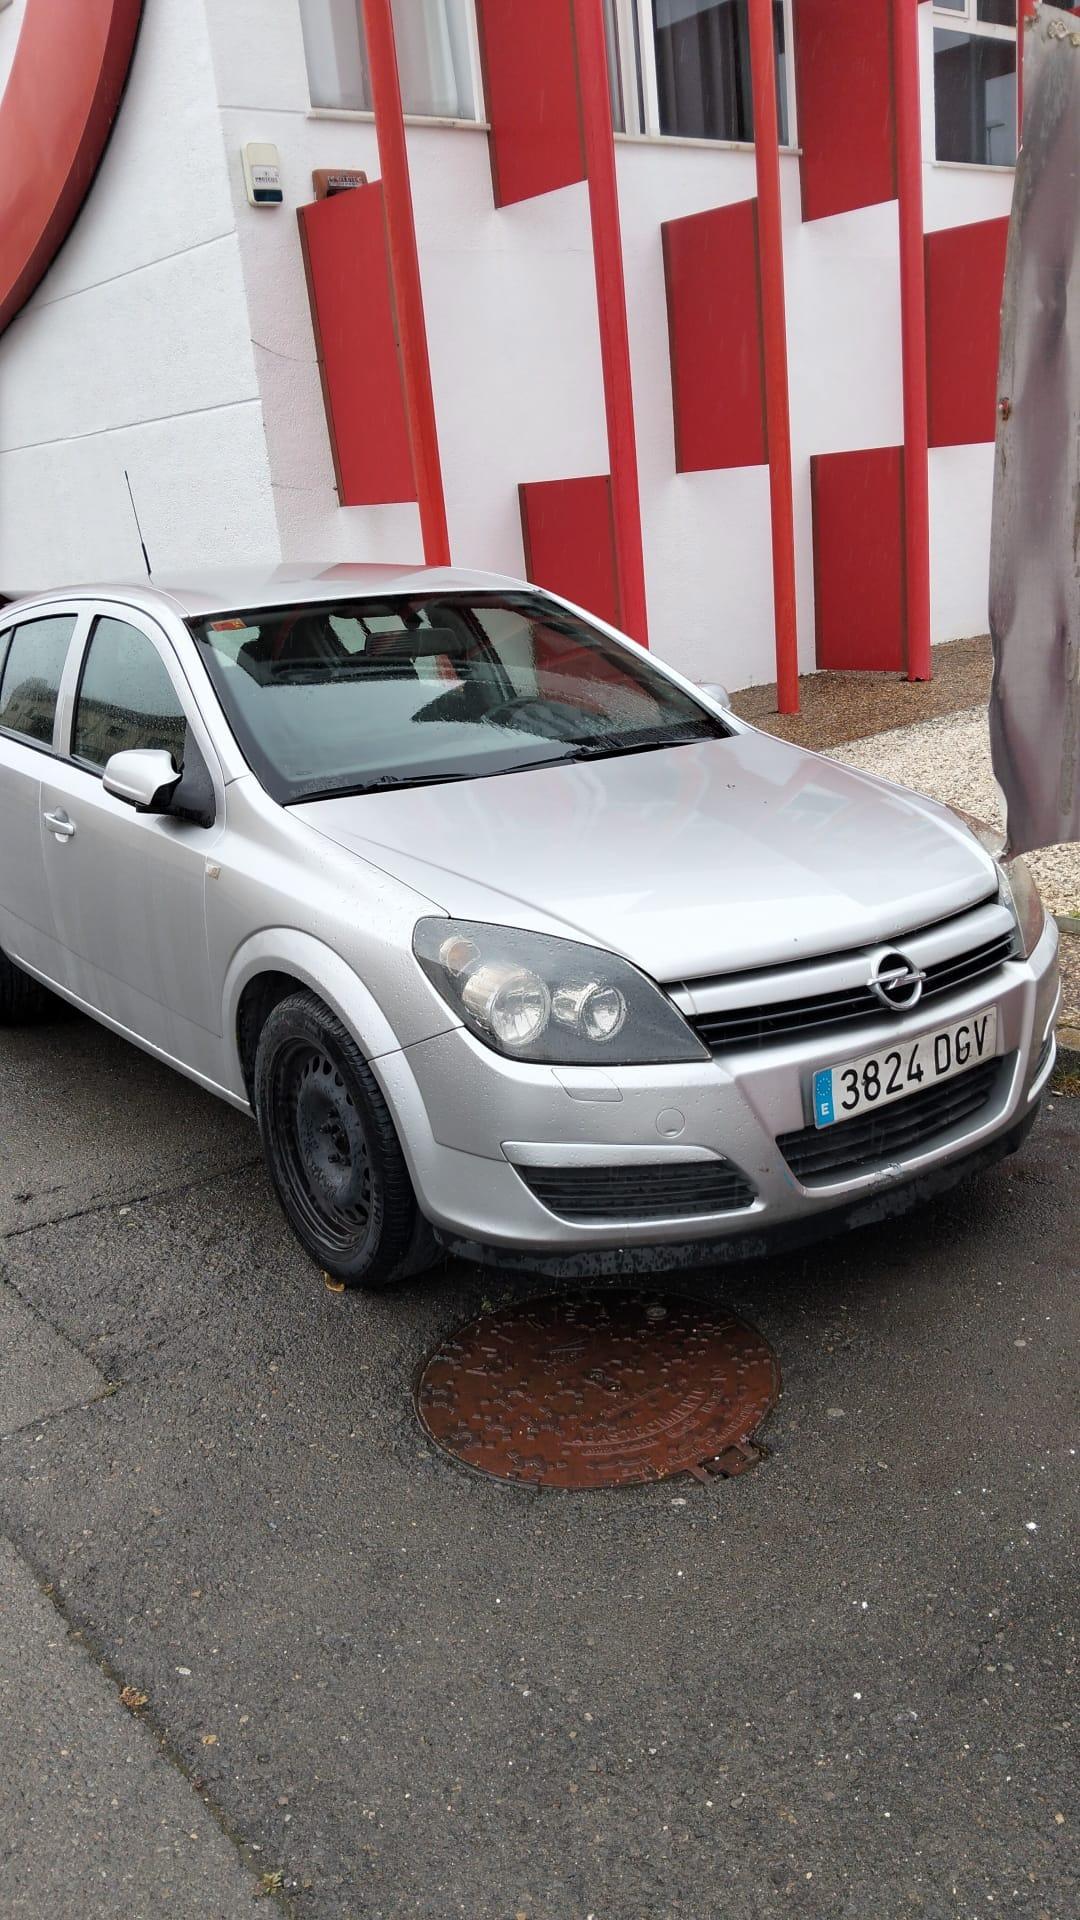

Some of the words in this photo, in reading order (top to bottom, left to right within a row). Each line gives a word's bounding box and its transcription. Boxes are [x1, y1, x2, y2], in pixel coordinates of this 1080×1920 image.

[840, 1043, 924, 1111] 3824
[934, 1016, 988, 1076] DGV
[821, 1102, 829, 1115] E
